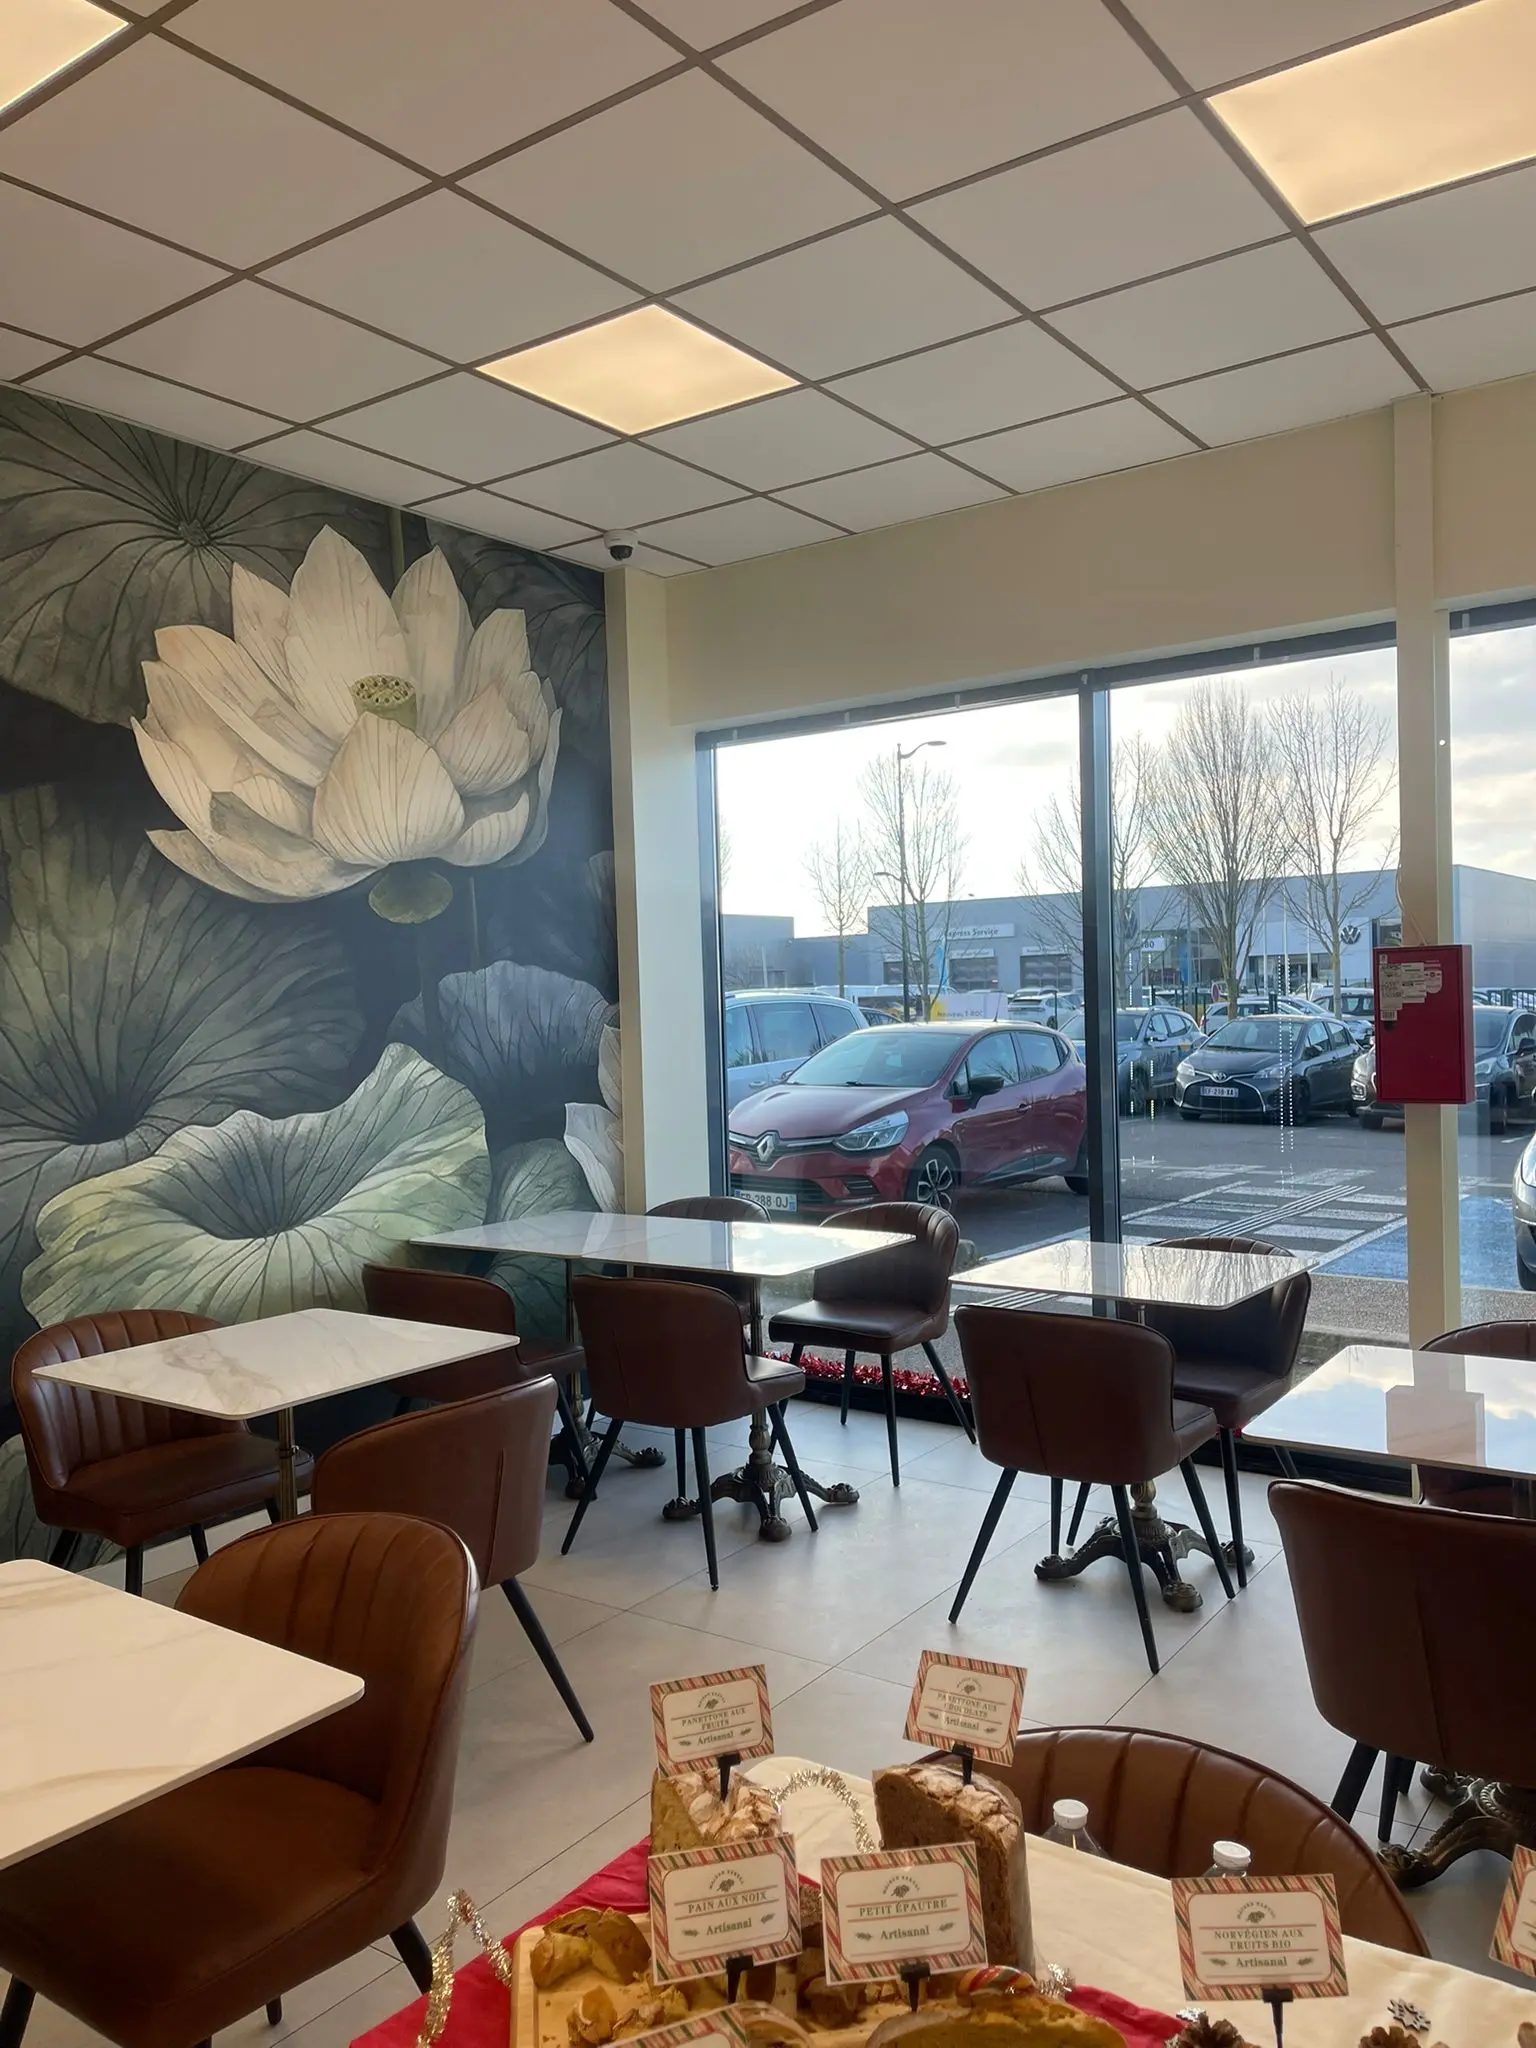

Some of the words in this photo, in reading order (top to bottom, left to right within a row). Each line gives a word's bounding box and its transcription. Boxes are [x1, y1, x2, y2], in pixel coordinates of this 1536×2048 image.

[682, 1712, 729, 1727] PANETTONE
[730, 1707, 747, 1717] AUX
[944, 1716, 979, 1731] Artisanal
[701, 1720, 729, 1731] FRUITS
[697, 1730, 734, 1746] Artisanal
[688, 1900, 714, 1914] PAIN
[717, 1896, 739, 1909] AUX
[741, 1891, 767, 1904] NOIX
[859, 1904, 892, 1917] PETIT
[895, 1899, 948, 1913] ÉPAUTRE
[706, 1917, 752, 1936] Artisanal
[880, 1925, 930, 1941] Artisanal
[1214, 1927, 1278, 1940] NORVÉGIEN
[1281, 1929, 1305, 1938] AUX
[1230, 1940, 1269, 1950] FRUITS
[1272, 1940, 1291, 1949] BIO
[1236, 1956, 1287, 1968] Artisanal
